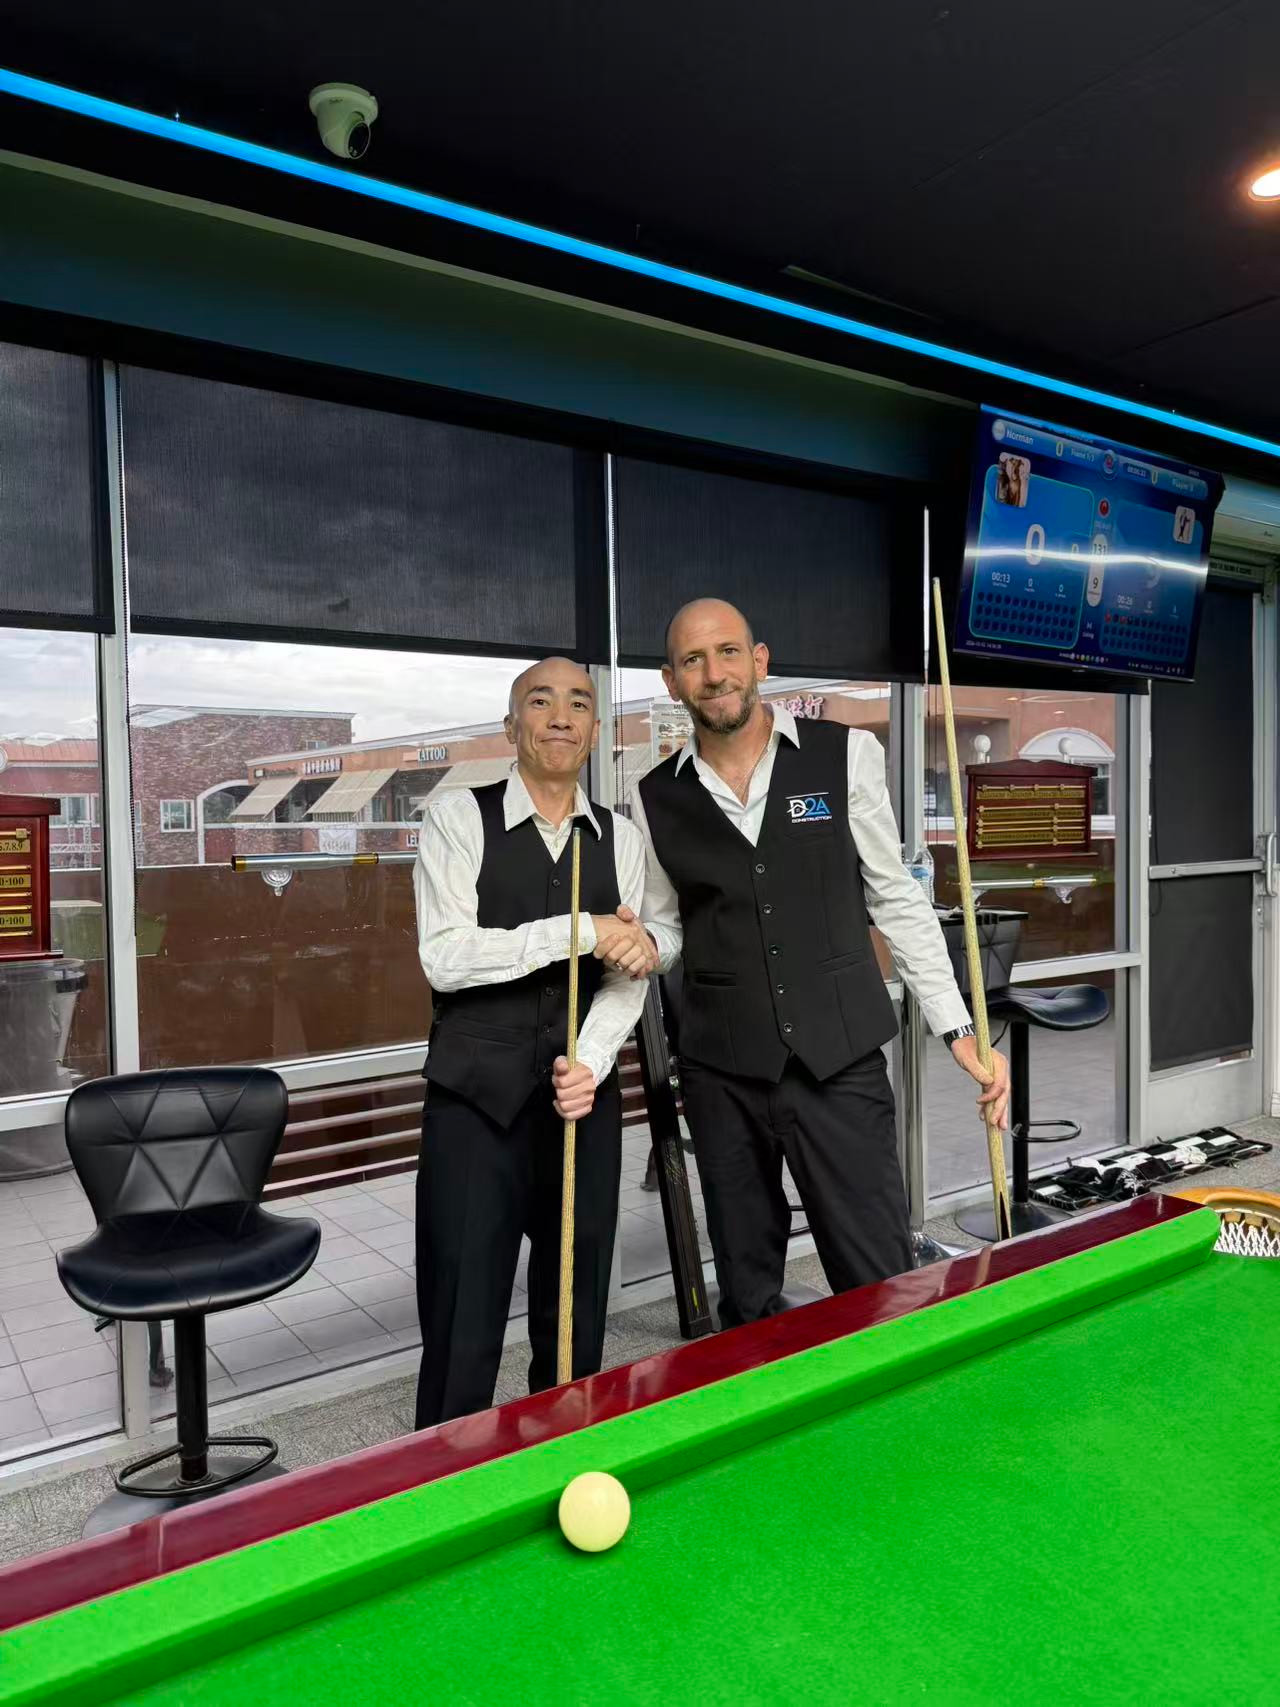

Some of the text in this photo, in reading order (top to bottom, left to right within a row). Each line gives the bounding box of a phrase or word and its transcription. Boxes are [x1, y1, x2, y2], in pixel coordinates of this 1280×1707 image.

[1006, 429, 1034, 446] Norman
[1056, 441, 1064, 457] 0
[1025, 524, 1045, 566] 0
[991, 571, 1011, 584] 00:13
[1092, 577, 1099, 589] 9
[417, 745, 447, 762] TATTOO
[791, 815, 832, 824] CONSTRUCTION
